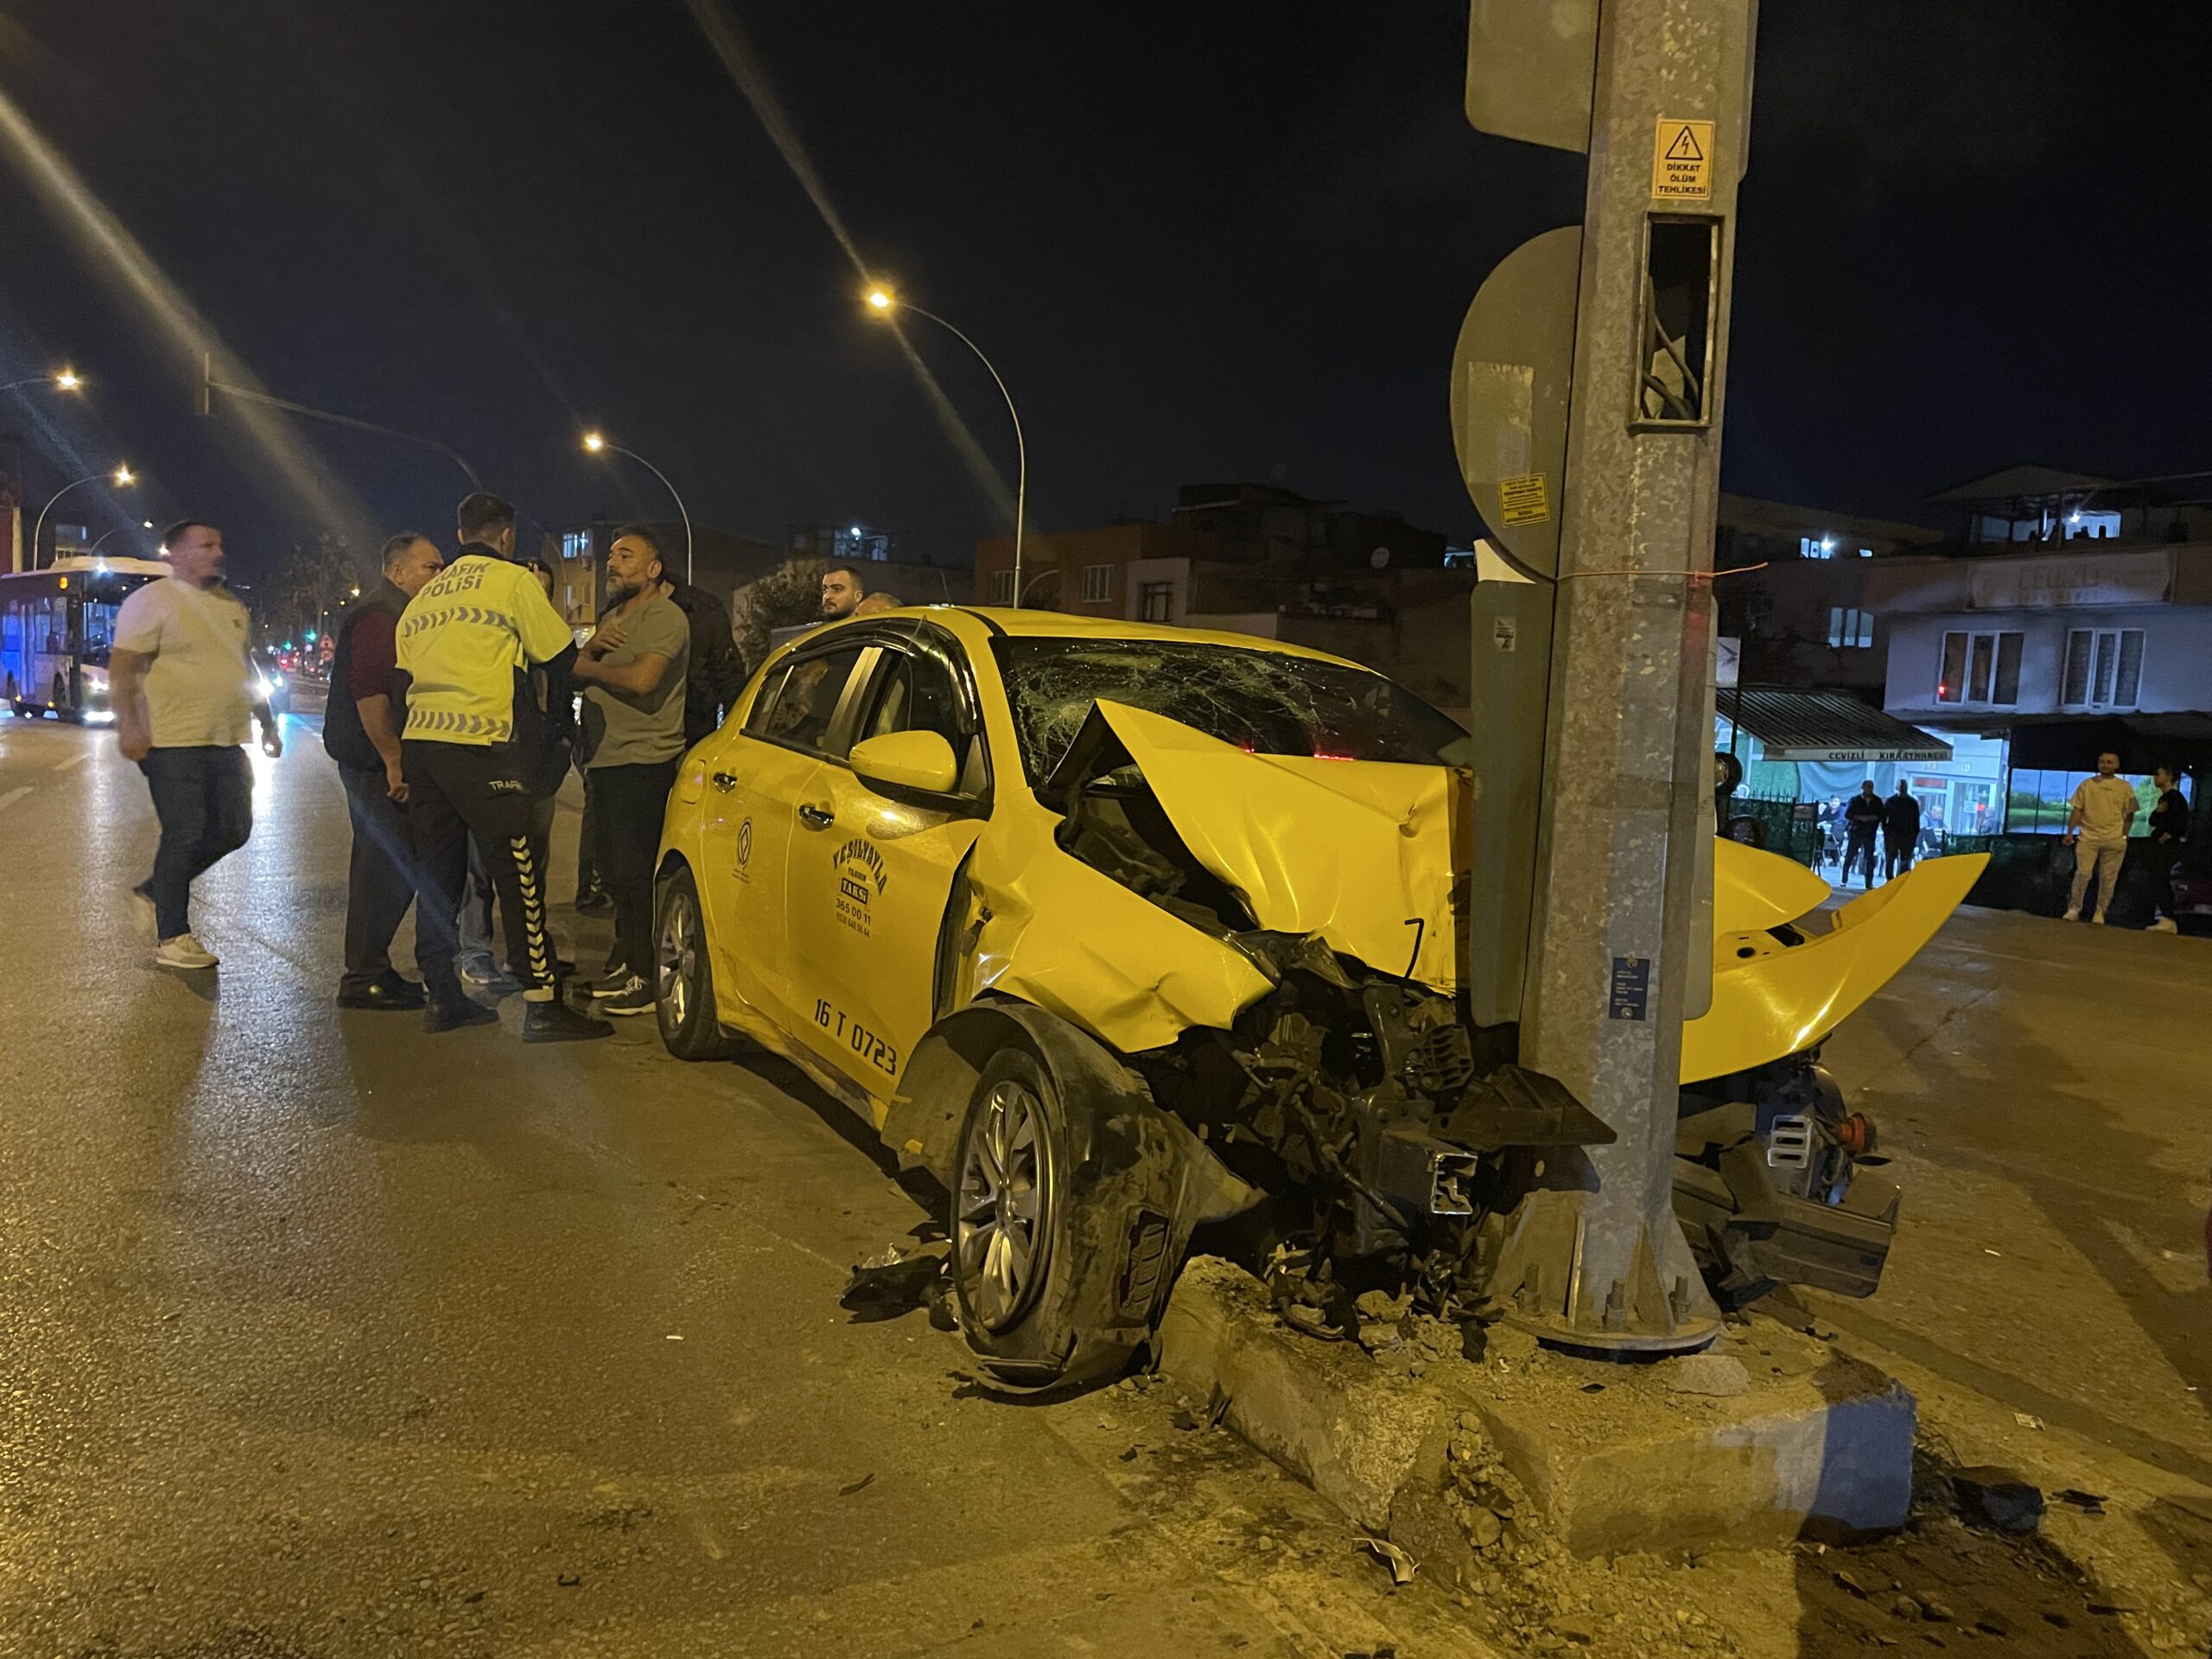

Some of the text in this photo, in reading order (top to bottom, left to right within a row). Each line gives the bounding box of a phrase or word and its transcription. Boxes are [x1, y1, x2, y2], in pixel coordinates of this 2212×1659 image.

[1667, 162, 1700, 171] DİKKAT
[1670, 174, 1696, 182] ÖLÜM
[1658, 185, 1706, 194] TEHLİKESİ
[421, 575, 484, 602] POLİSİ
[1828, 750, 1865, 760] CEVİZLİ
[842, 879, 867, 904] TAKSİ
[836, 898, 871, 926] 365 00 11
[814, 998, 897, 1077] 16 T 0723
